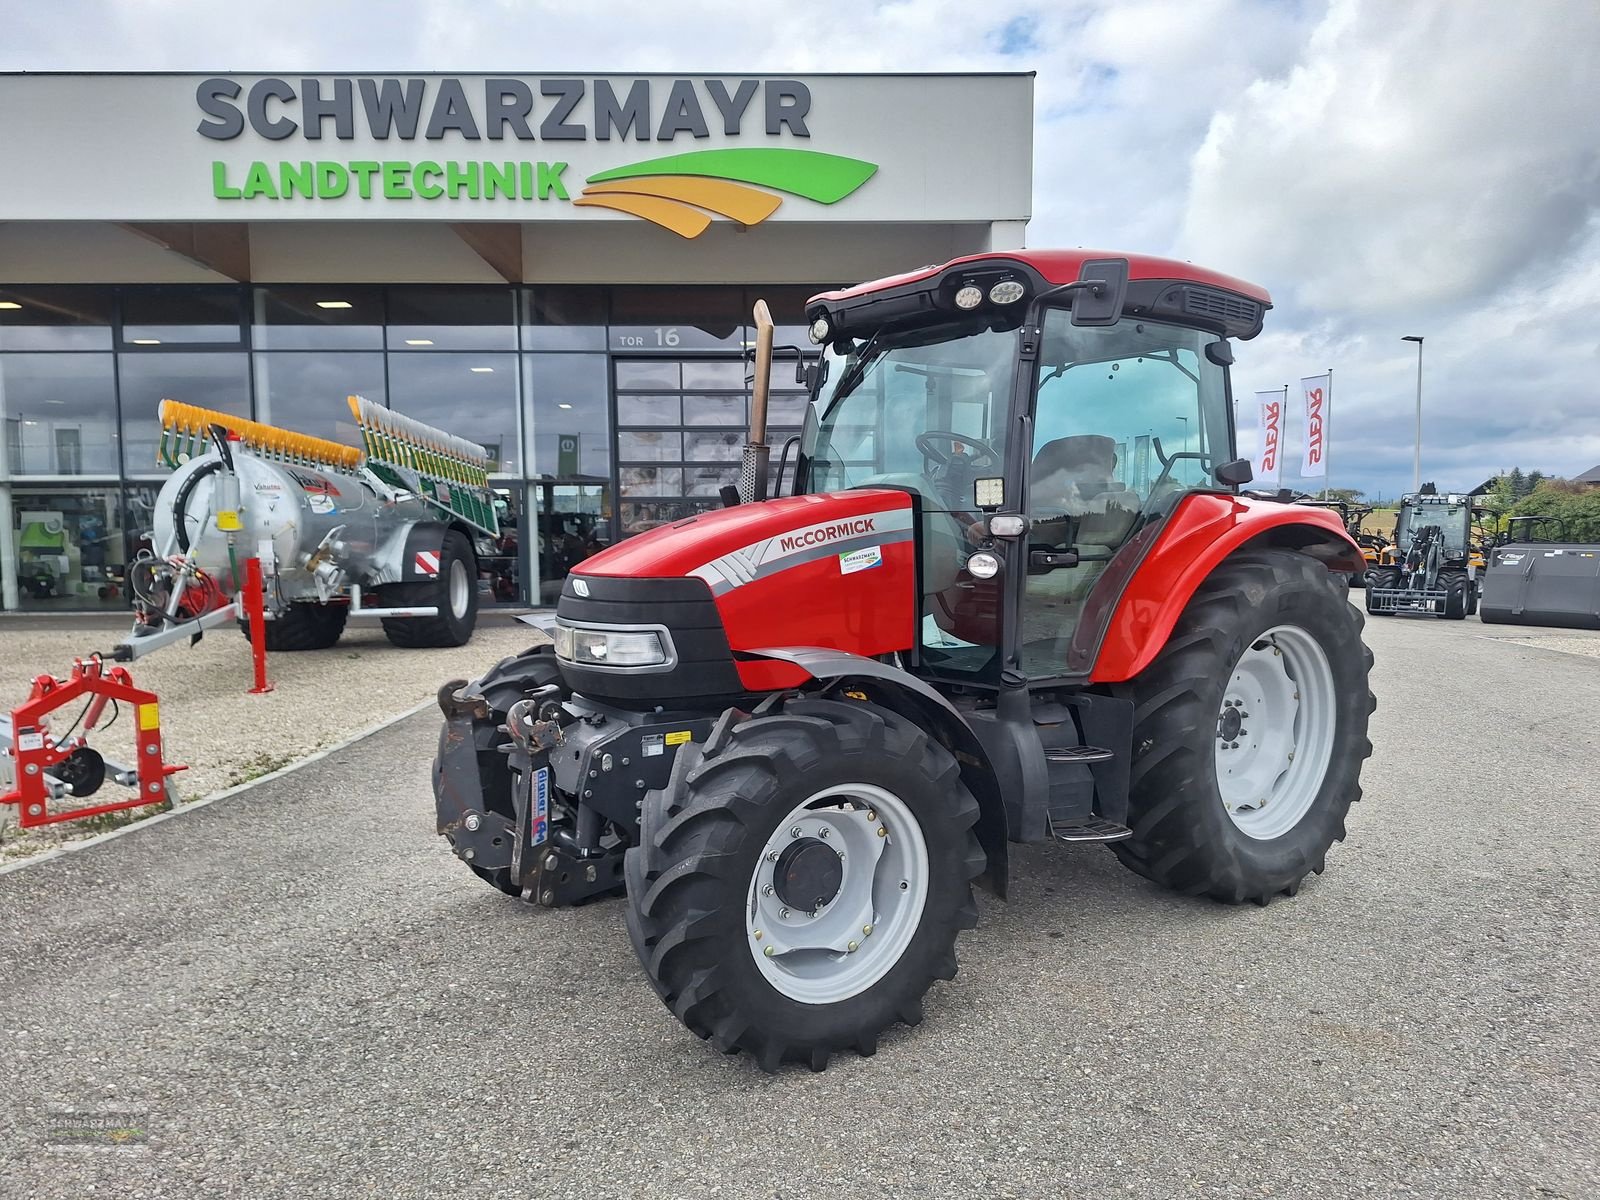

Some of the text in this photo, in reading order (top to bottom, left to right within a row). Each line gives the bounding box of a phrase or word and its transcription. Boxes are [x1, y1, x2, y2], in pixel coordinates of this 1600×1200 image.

[196, 78, 811, 141] SCHWARZMAYR
[212, 161, 570, 200] LANDTECHNIK
[619, 327, 680, 346] TOR 16
[780, 518, 876, 552] McCORMICK
[843, 551, 876, 563] SCHWARZMAYR
[538, 769, 547, 812] Aigner
